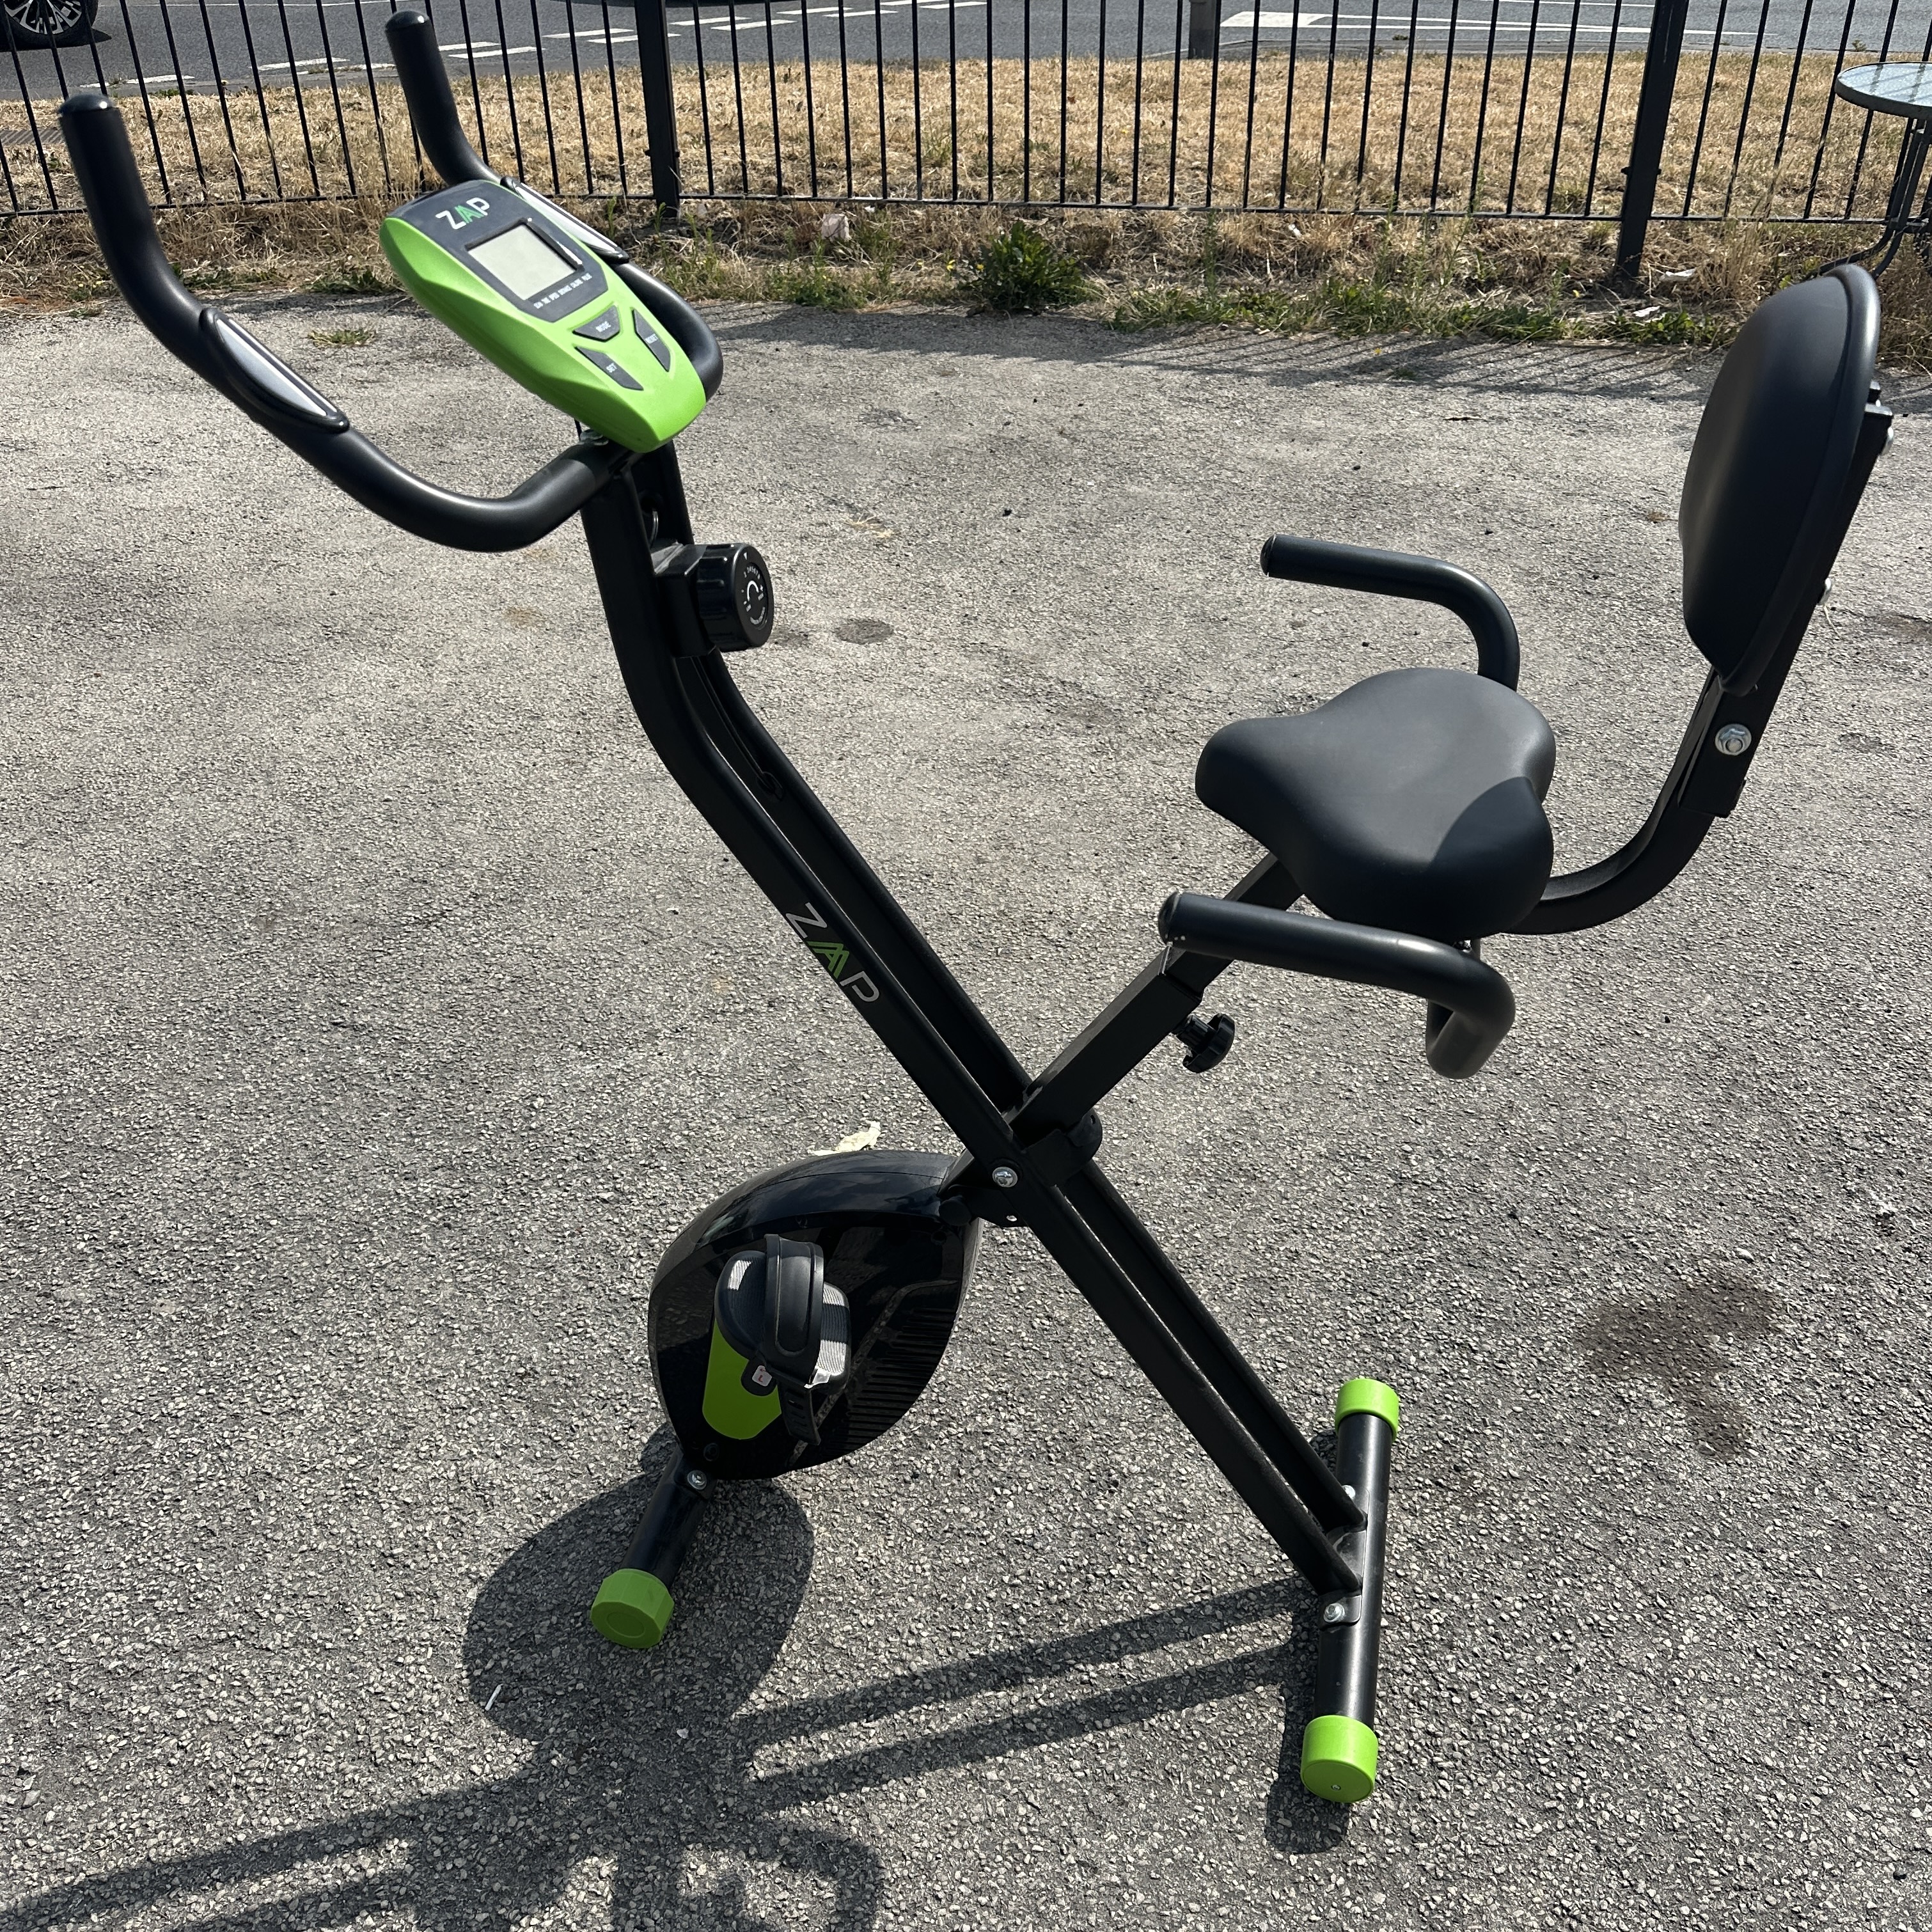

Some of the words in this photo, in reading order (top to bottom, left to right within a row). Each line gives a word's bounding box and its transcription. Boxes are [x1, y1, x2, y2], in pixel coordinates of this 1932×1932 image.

[435, 197, 490, 230] ZAP
[595, 321, 611, 333] MODE
[645, 333, 659, 344] RESET
[606, 363, 617, 373] SET
[785, 902, 880, 1002] ZAP
